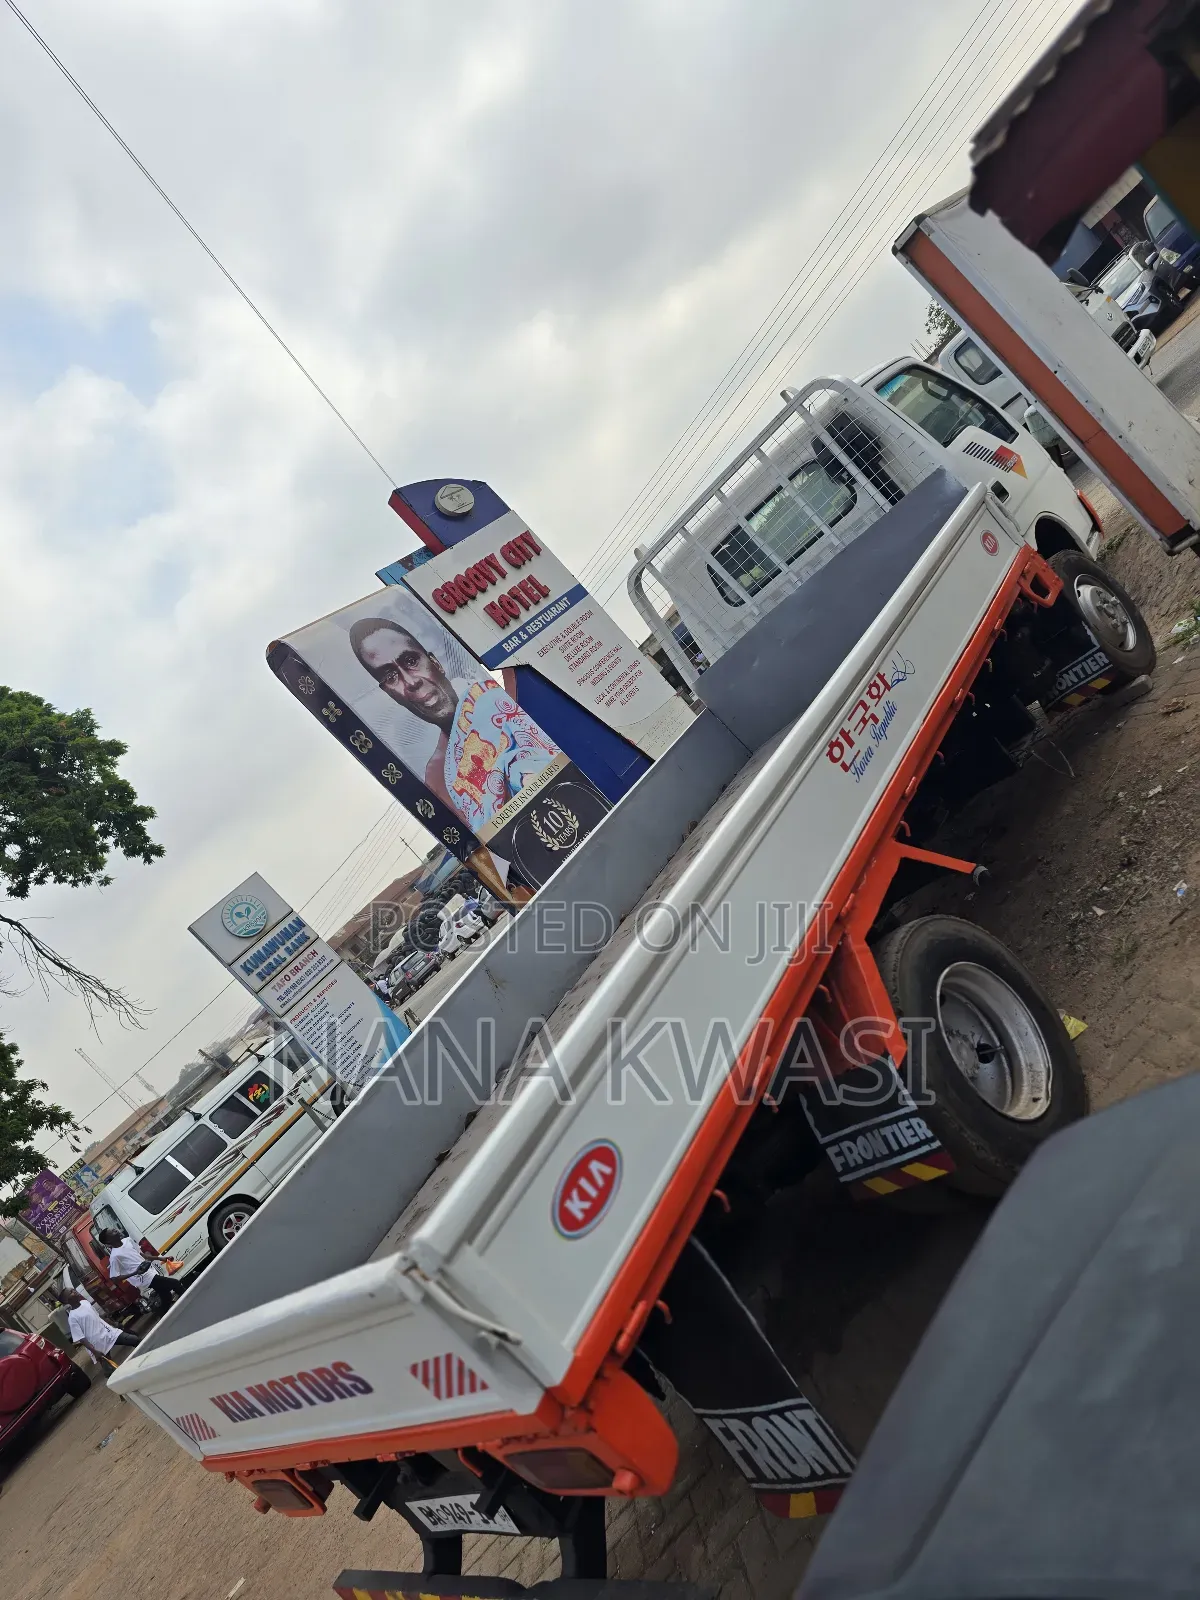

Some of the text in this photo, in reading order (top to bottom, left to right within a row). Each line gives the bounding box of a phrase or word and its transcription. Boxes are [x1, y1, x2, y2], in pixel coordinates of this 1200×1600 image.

[984, 536, 996, 551] KIA
[432, 531, 541, 614] GROOVY CITY
[484, 575, 550, 629] HOTEL
[502, 597, 570, 652] BAR & RESTUARANT
[537, 636, 562, 657] EXECUTIVE
[563, 619, 582, 636] DOUBLE
[579, 610, 593, 622] ROOM
[559, 630, 584, 653] SUITE ROOM
[564, 636, 593, 662] DELUXE ROOM
[568, 641, 602, 672] STANDARD ROOM
[612, 643, 622, 653] HALL
[594, 692, 607, 704] LOCAL
[1047, 652, 1109, 698] ONTIER
[826, 672, 891, 773] 한국화
[851, 700, 898, 783] Korea Republic
[492, 761, 559, 828] FOREVER IN OUR HEARTS
[542, 811, 564, 834] 10
[556, 825, 574, 844] YEARS
[241, 918, 305, 975] KUMAWUMAN
[256, 932, 310, 981] RURAL BANK
[272, 949, 318, 992] TAFO BRANCH
[290, 1002, 312, 1024] PRODUCTS
[317, 979, 337, 998] SERVICES
[294, 997, 326, 1028] CURRENT ACCOUNT
[313, 1003, 329, 1018] ACCOUNT
[825, 1116, 933, 1173] FRONTIER
[564, 1159, 613, 1222] KIA
[209, 1361, 374, 1423] KIA MOTORS
